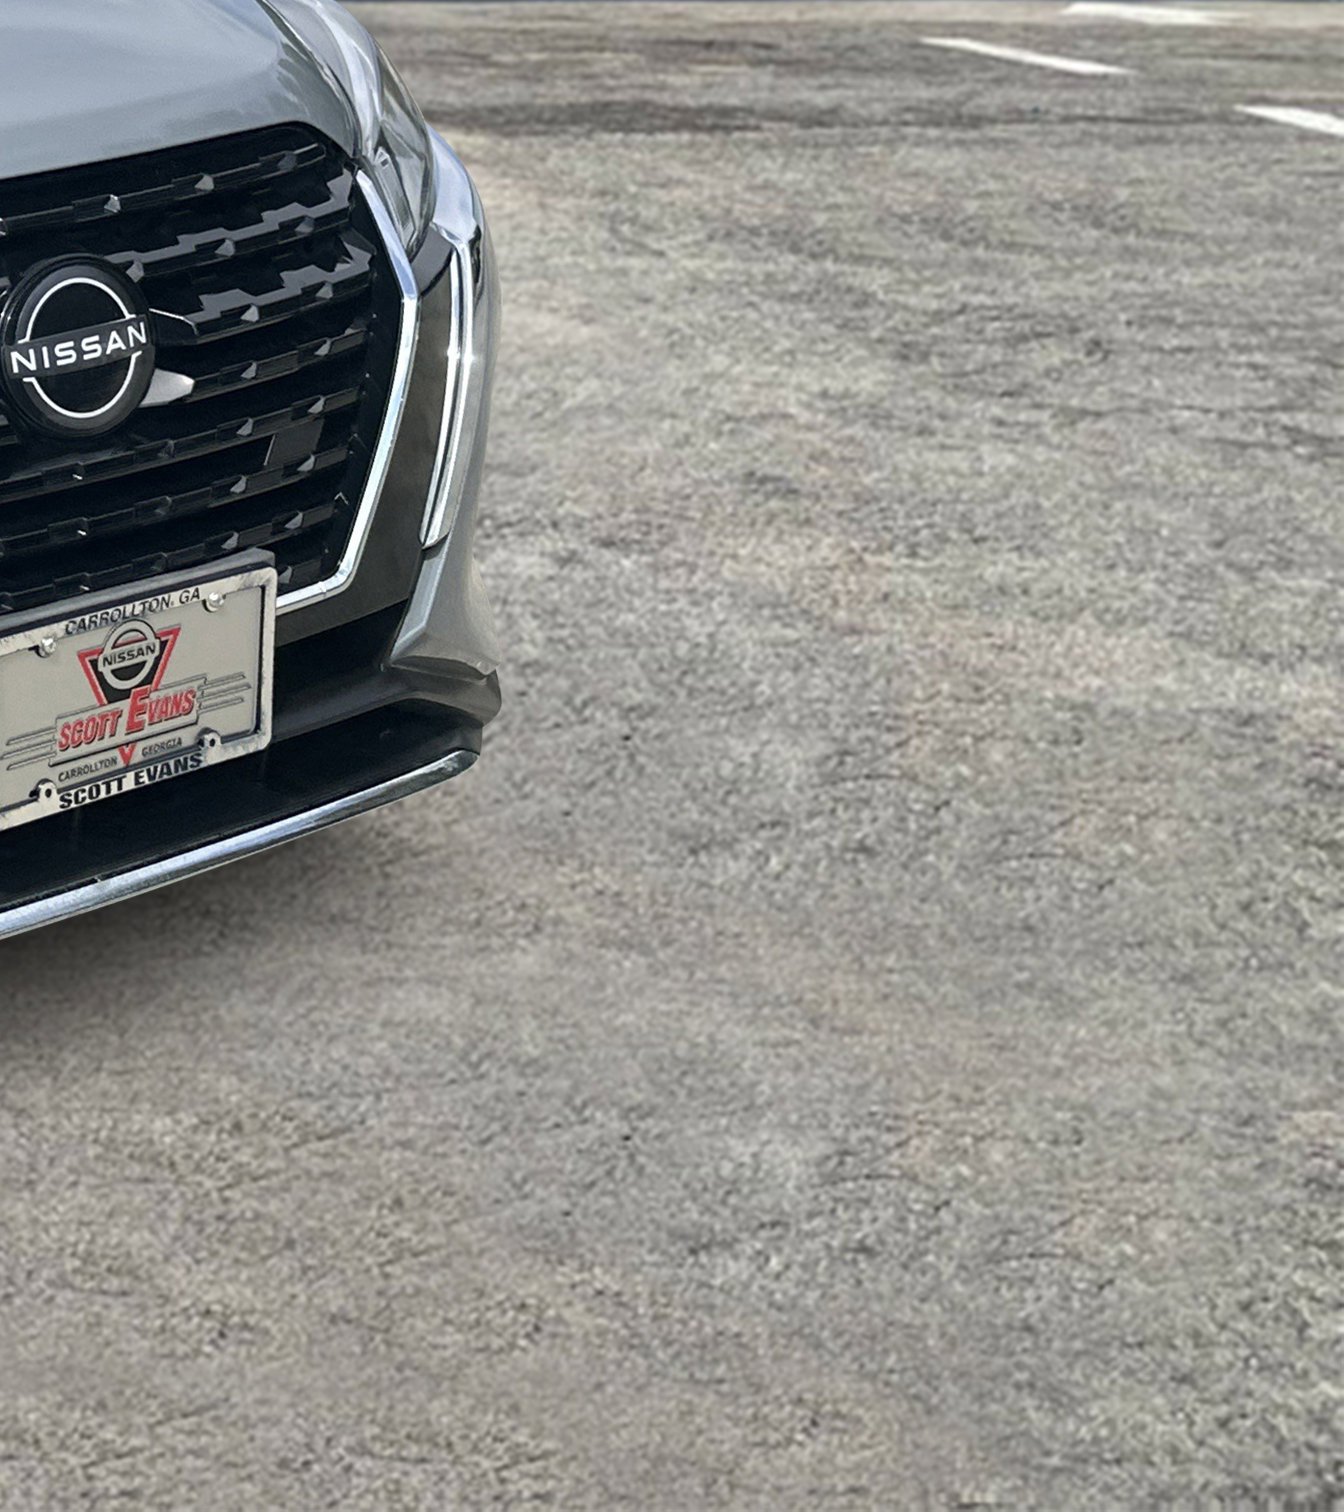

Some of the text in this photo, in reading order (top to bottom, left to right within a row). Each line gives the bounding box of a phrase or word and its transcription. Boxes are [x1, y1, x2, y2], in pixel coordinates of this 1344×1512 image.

[10, 321, 148, 374] NISSAN
[178, 586, 201, 605] GA
[102, 642, 156, 668] NISSAN
[57, 687, 197, 752] SCOTT EVANS
[58, 737, 183, 783] CARROLLTON GEORGIA
[59, 752, 204, 810] SCOTT EVANS
